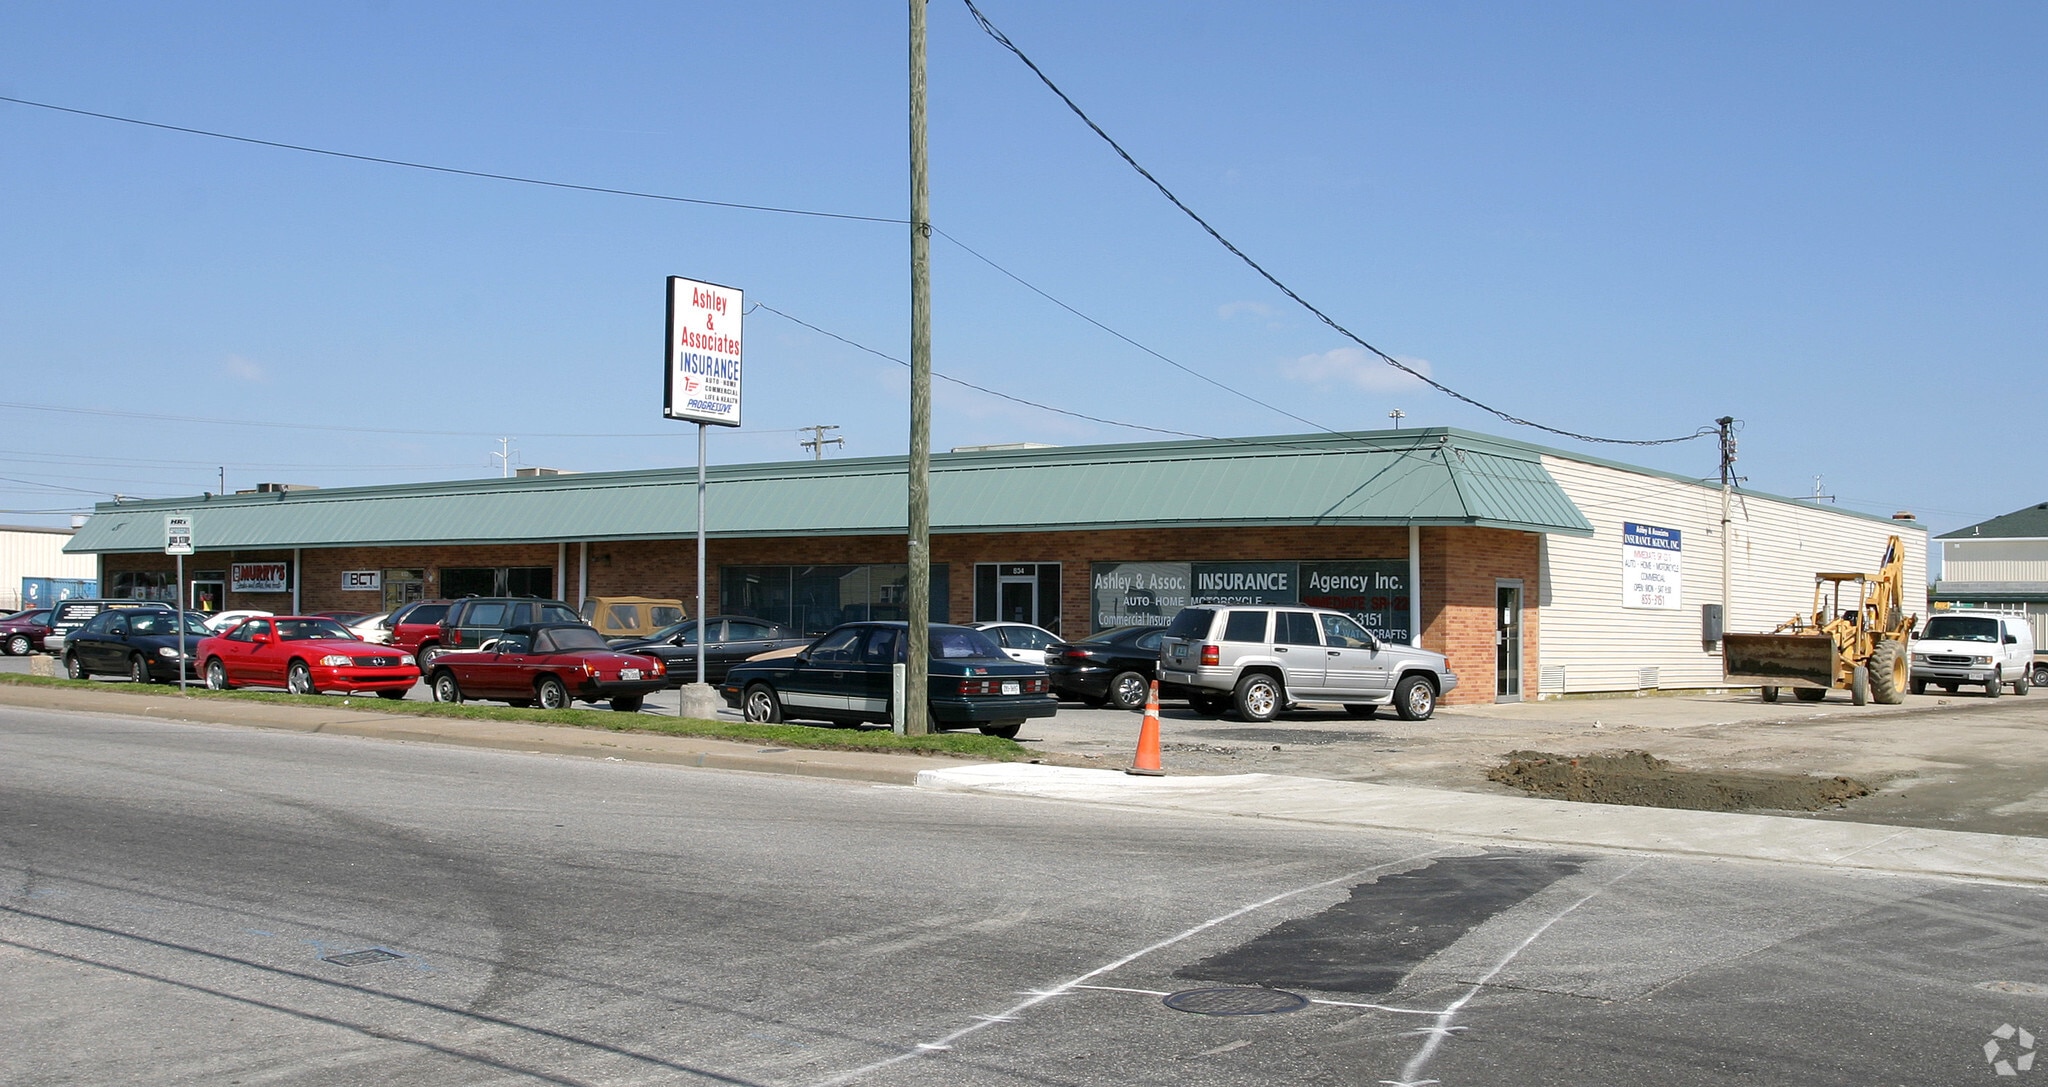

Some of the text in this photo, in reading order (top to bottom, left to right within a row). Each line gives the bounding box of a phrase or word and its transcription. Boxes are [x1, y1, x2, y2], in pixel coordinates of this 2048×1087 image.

[692, 286, 727, 316] Ashley
[706, 313, 714, 331] &
[681, 325, 740, 356] Associates
[680, 351, 740, 381] INSURANCE
[705, 376, 719, 385] AUTO
[704, 385, 738, 396] COMMERCIAL
[687, 398, 732, 414] PROGRESSIVE
[240, 565, 285, 581] MURRY'S
[350, 573, 375, 585] BCT
[1094, 572, 1404, 594] Ashley & Assoc. INSURANCE Agency Inc.
[1123, 597, 1149, 606] AUTO
[1155, 597, 1185, 606] HOME
[1098, 612, 1145, 626] Commercial
